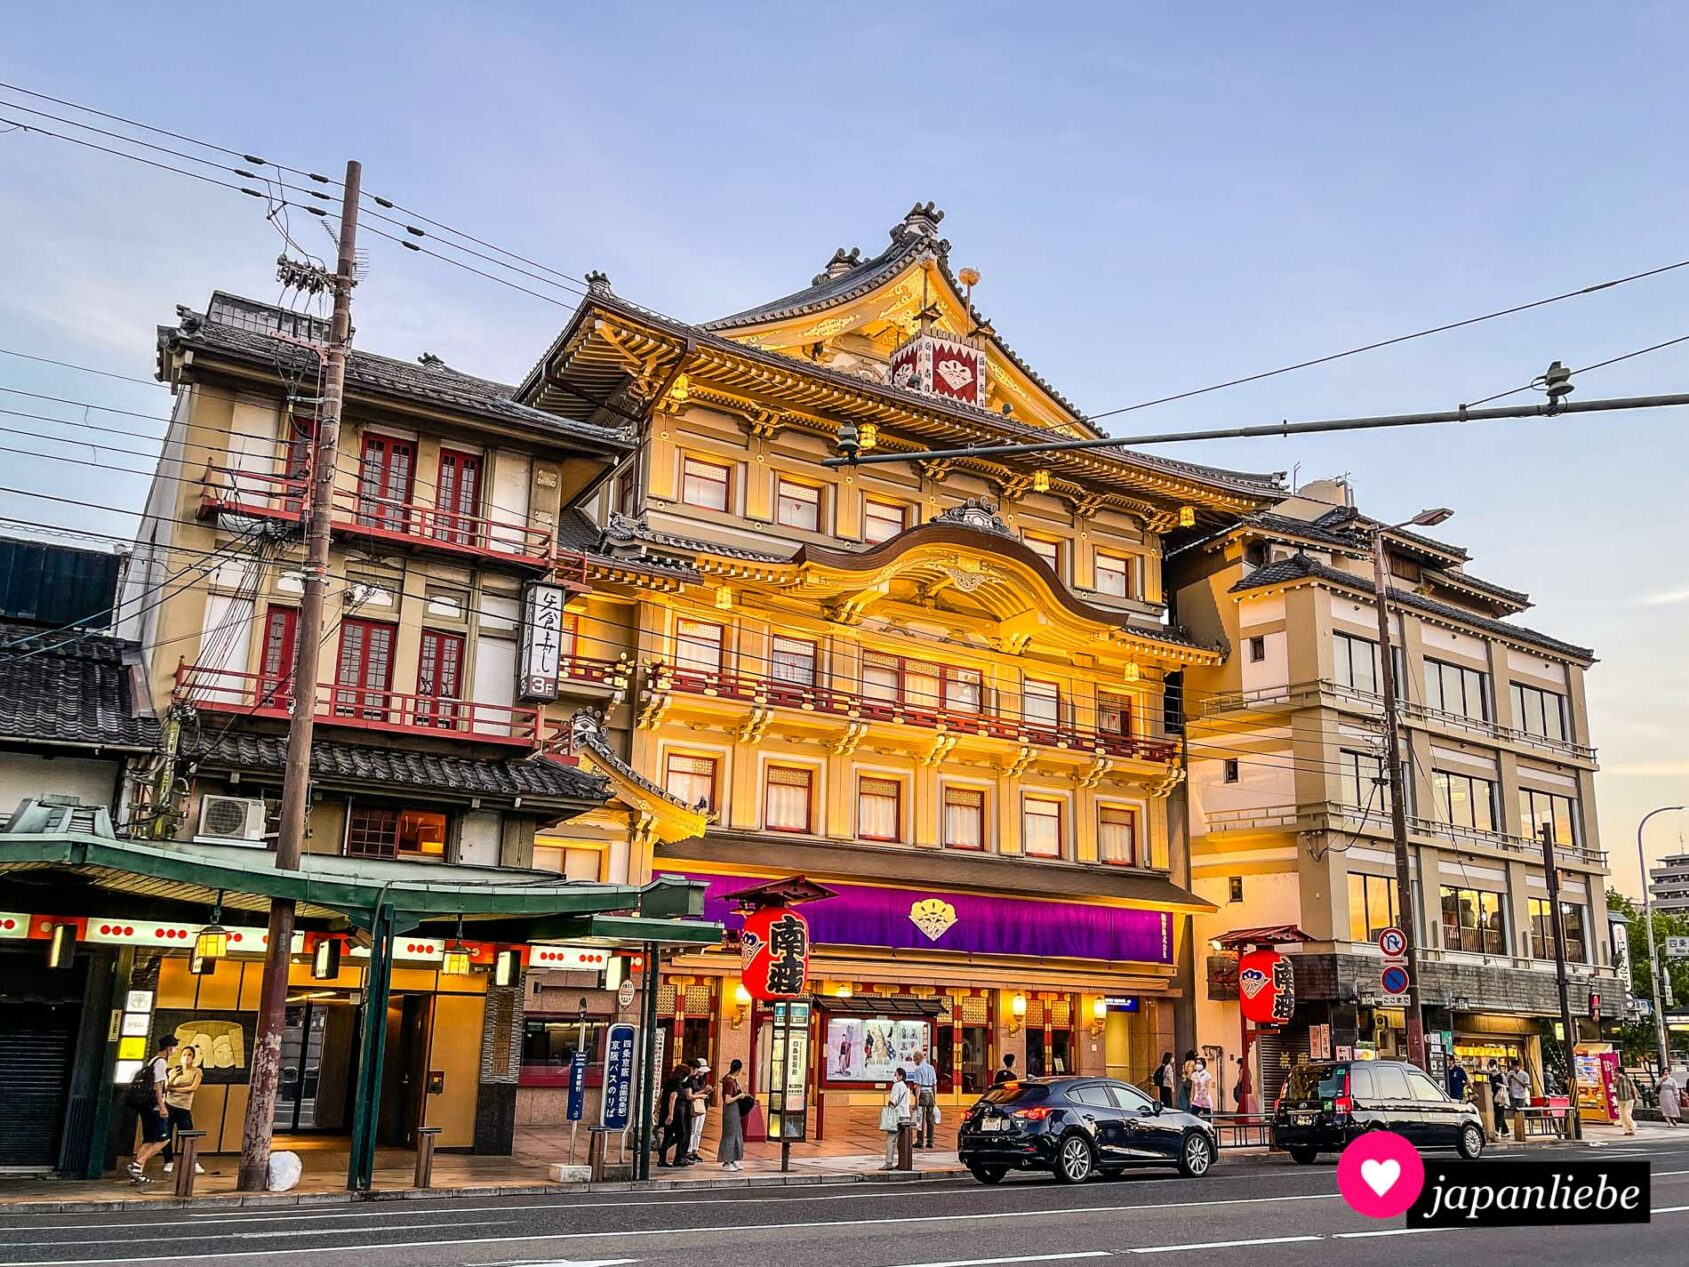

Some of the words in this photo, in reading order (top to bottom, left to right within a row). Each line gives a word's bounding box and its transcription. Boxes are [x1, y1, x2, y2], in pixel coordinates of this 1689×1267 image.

[532, 677, 554, 693] 3F
[766, 914, 806, 995] 南座
[606, 1040, 620, 1118] 京阪バスのりば
